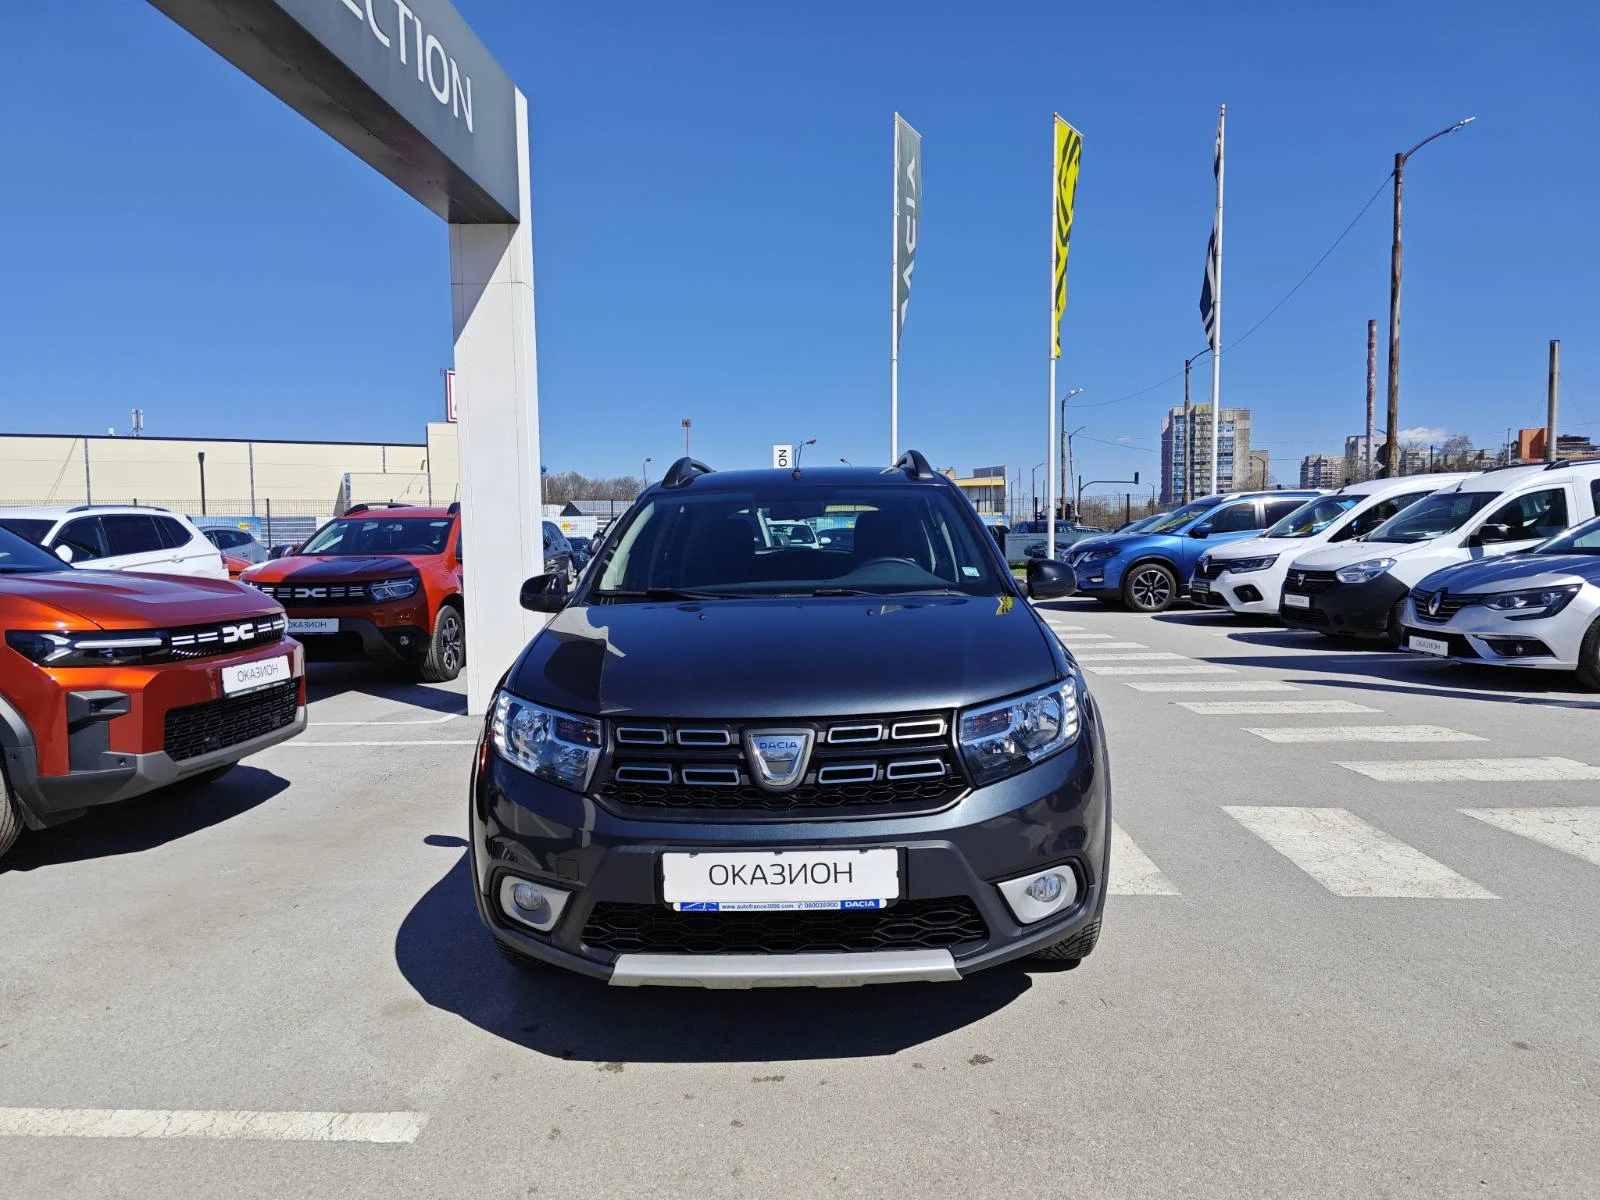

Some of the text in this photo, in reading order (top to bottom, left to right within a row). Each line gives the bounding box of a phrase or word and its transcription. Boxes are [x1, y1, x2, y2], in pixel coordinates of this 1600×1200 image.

[343, 0, 473, 133] CTION
[237, 663, 279, 682] ОКАЗИОН
[759, 741, 798, 749] DACIA
[708, 861, 853, 886] ОКАЗИОН
[721, 902, 794, 910] www.autofrance3000.com
[845, 900, 876, 908] DACIA
